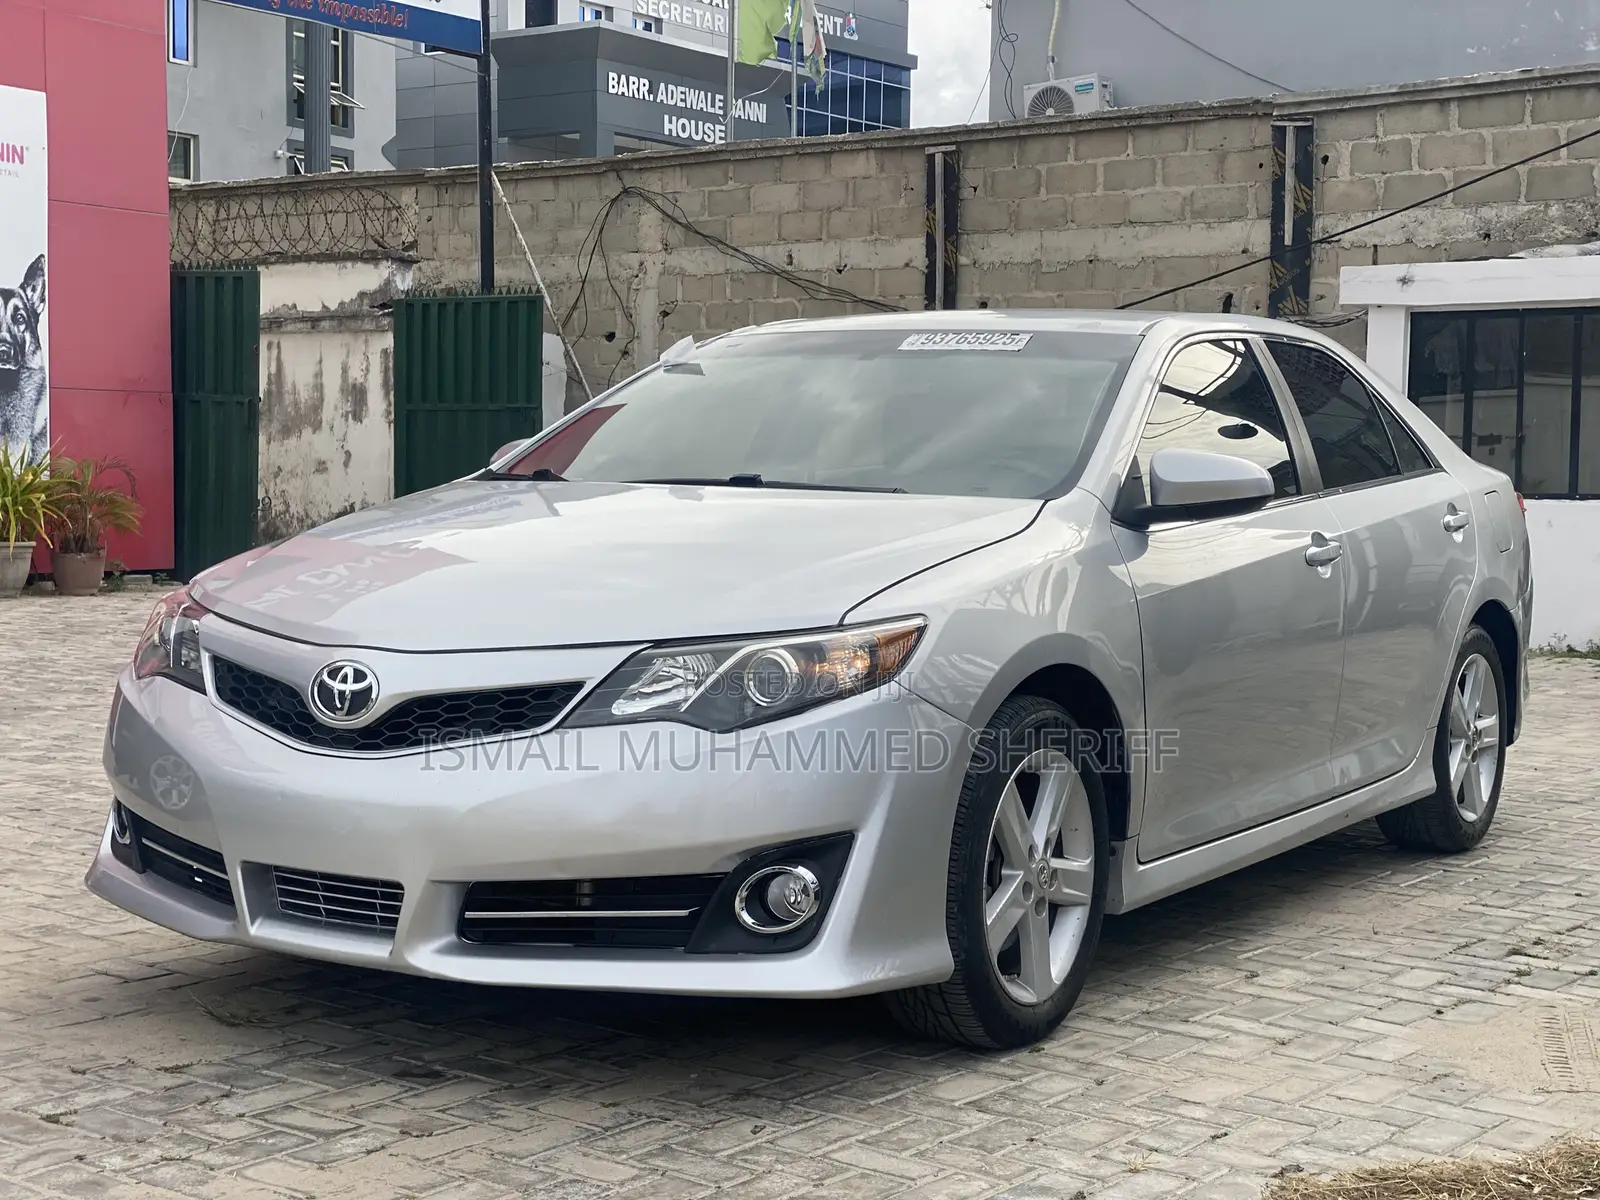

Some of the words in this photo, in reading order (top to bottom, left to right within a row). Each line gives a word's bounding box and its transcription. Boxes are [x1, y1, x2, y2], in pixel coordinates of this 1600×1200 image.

[608, 71, 654, 102] BARR.
[656, 82, 724, 115] ADEWALE
[732, 97, 767, 123] ANNI
[663, 114, 726, 144] HOUSE
[920, 333, 1020, 346] 93765925
